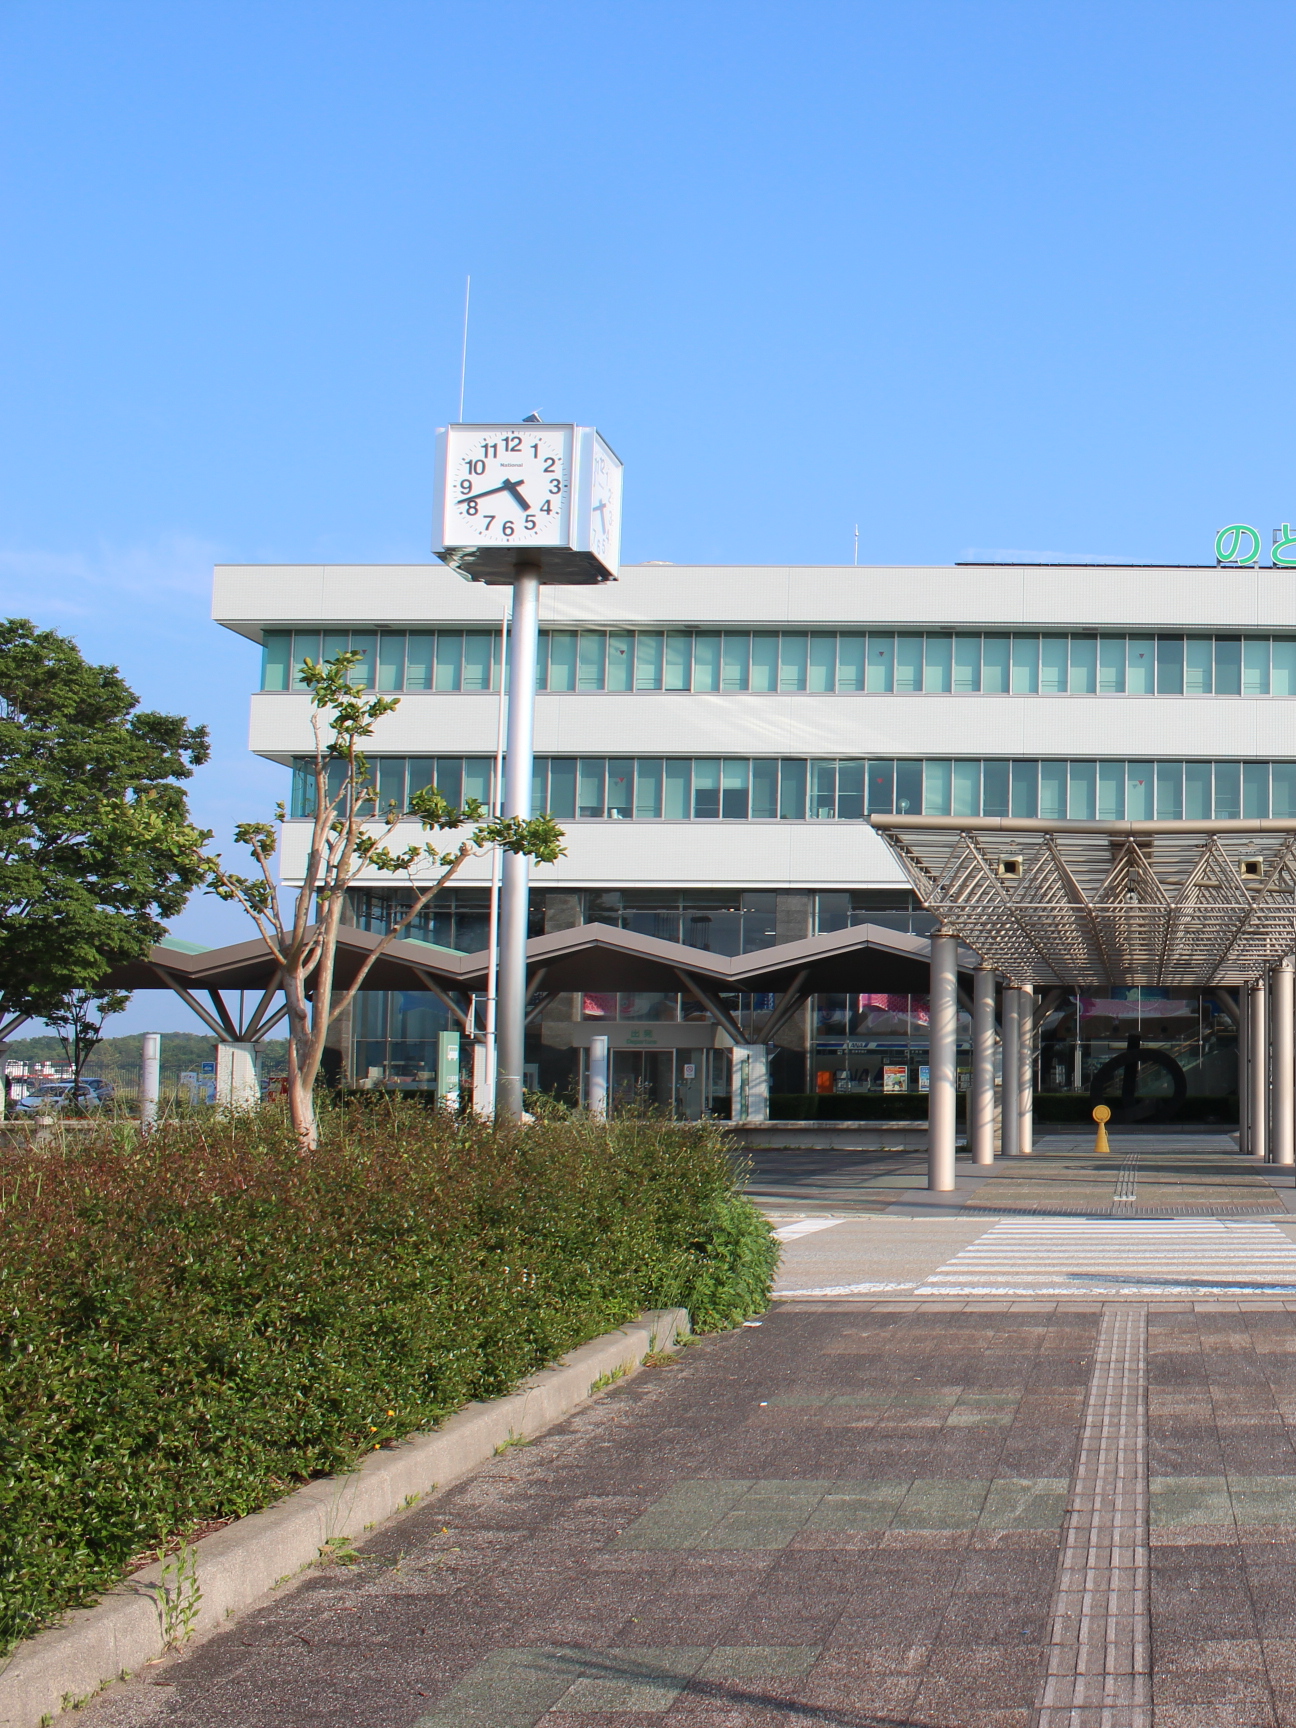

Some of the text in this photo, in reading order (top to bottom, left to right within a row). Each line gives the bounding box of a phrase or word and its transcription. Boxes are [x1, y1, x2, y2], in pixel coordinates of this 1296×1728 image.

[481, 443, 498, 459] 11
[502, 436, 522, 452] 12
[531, 443, 539, 459] 1
[465, 459, 486, 475] 10
[543, 457, 556, 473] 2
[460, 479, 473, 495] 9
[549, 478, 562, 495] 3
[466, 499, 479, 516] 8
[540, 500, 552, 515] 4
[483, 515, 496, 531] 7
[502, 520, 514, 537] 6
[524, 515, 536, 530] 5
